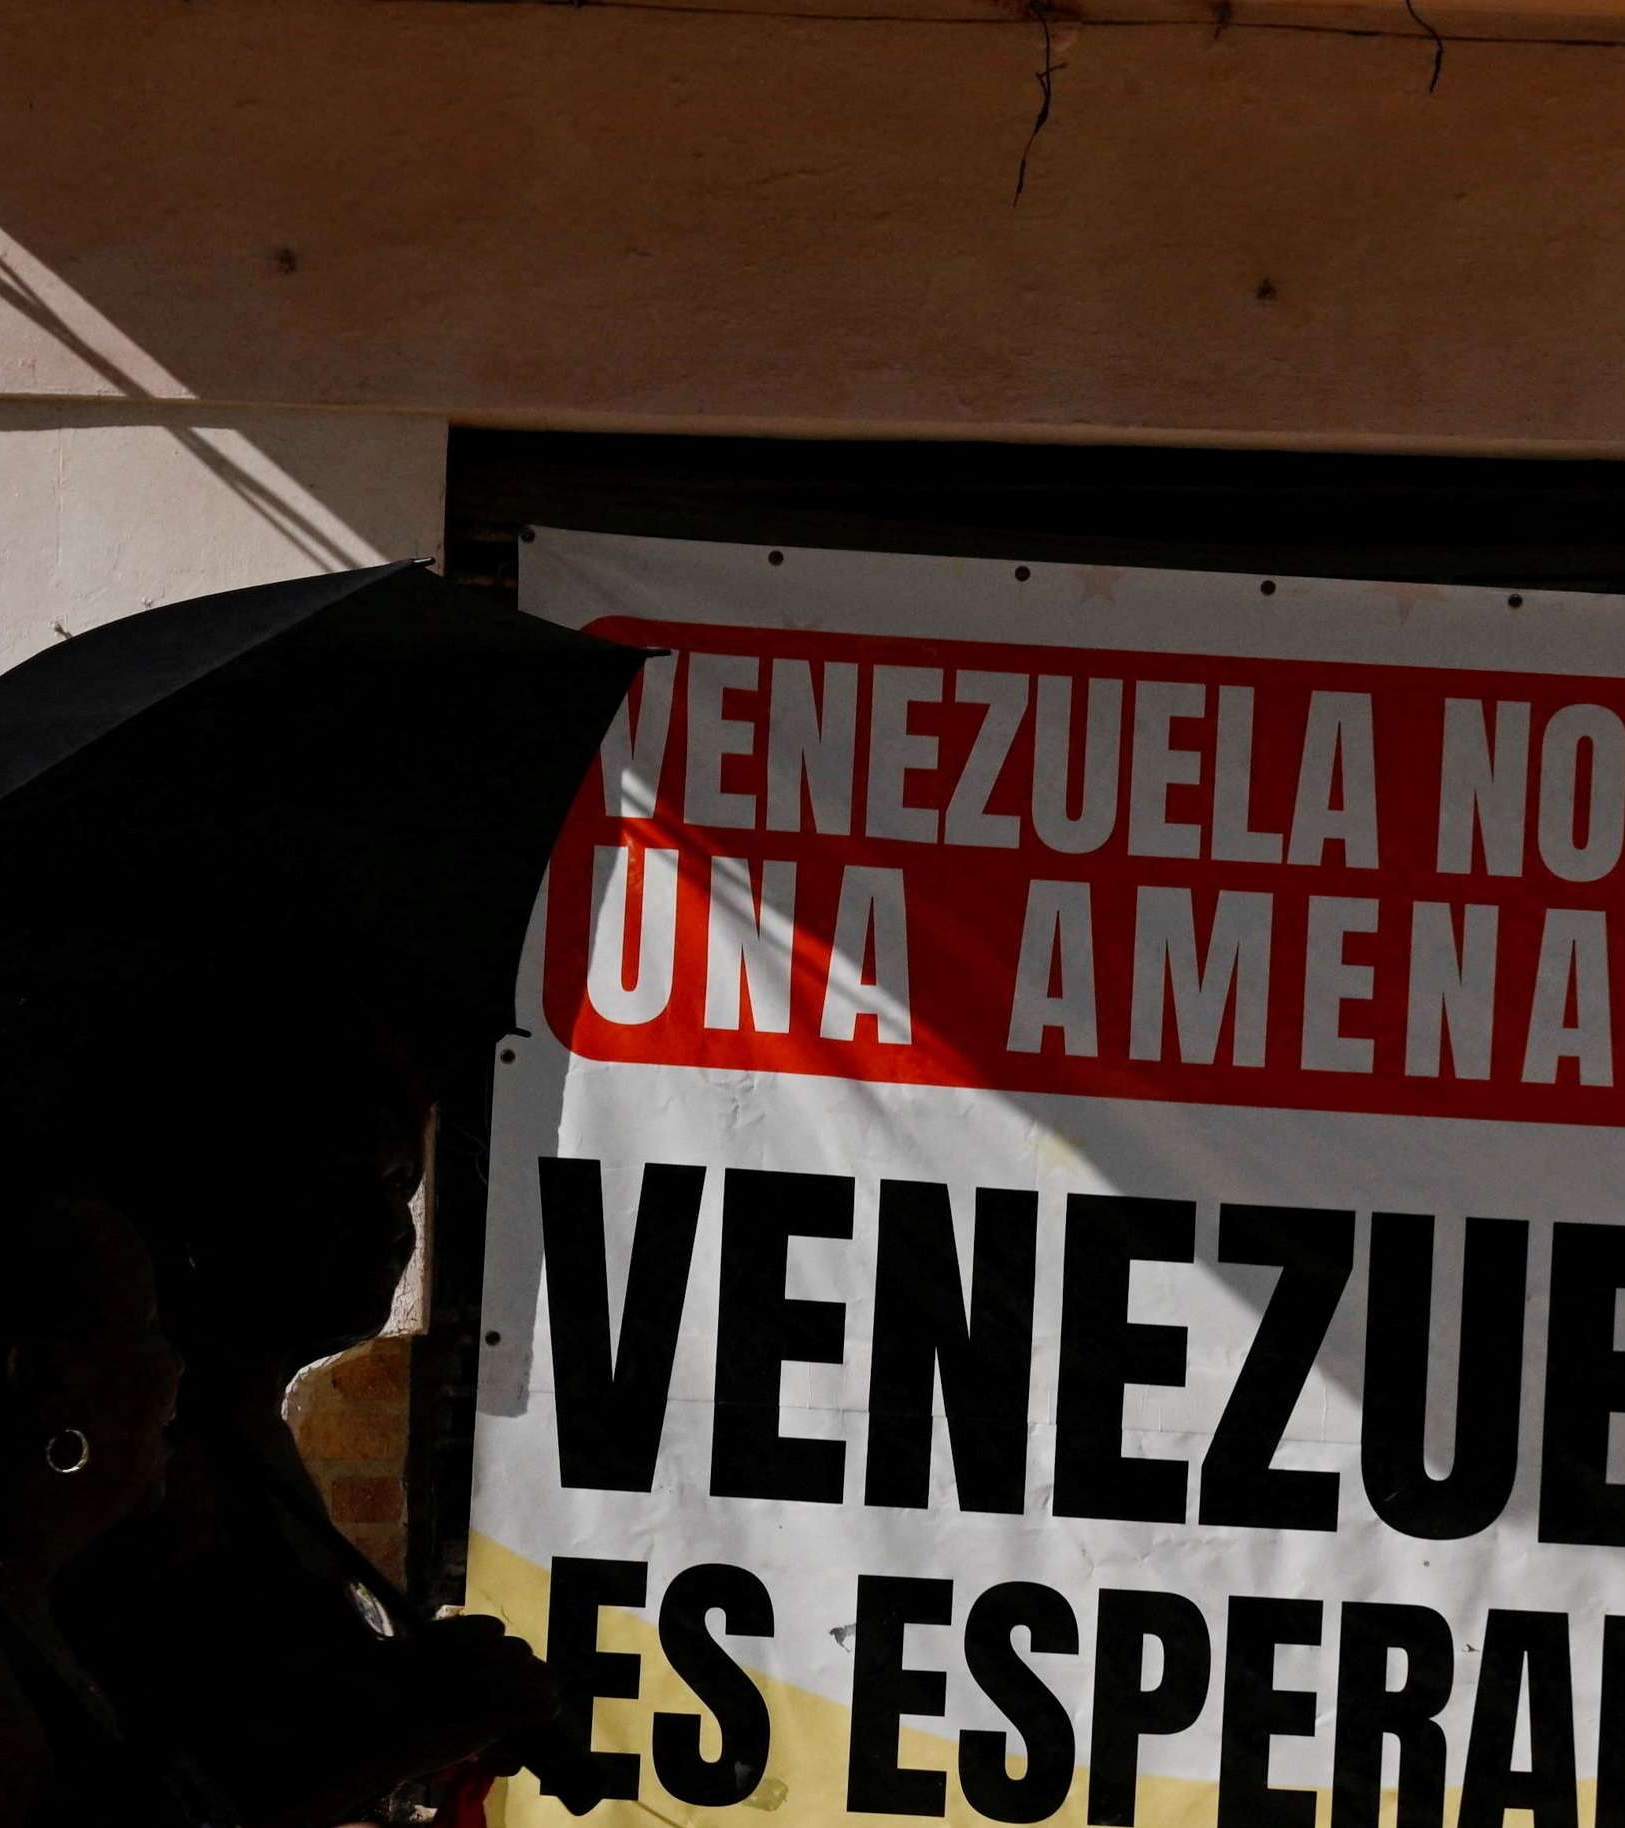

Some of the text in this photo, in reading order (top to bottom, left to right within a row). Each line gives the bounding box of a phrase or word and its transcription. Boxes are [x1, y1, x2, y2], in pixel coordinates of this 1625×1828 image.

[600, 648, 1379, 870] VENEZUELA
[586, 845, 913, 1046] UNA
[540, 1556, 775, 1806] ES
